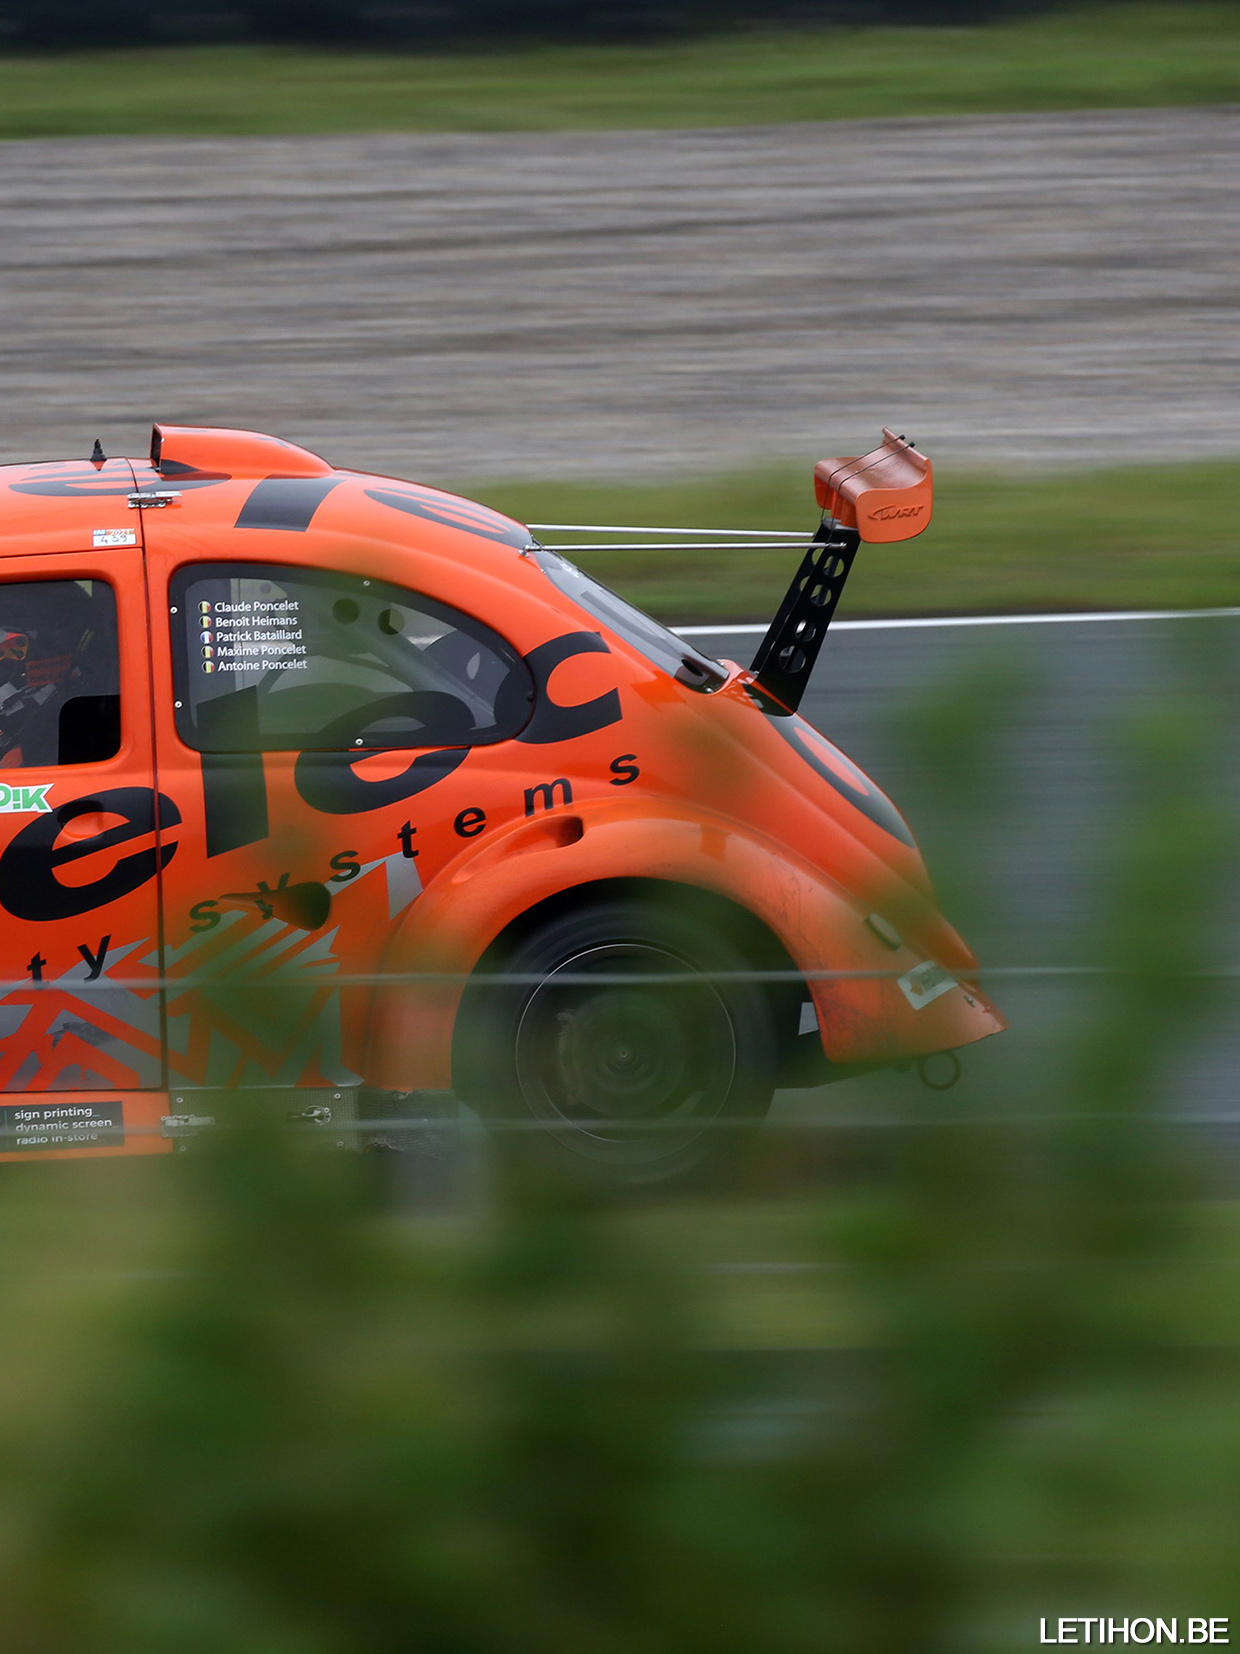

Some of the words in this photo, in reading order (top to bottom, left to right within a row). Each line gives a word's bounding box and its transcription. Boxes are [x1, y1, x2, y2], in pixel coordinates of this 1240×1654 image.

[215, 601, 252, 613] Claude
[253, 600, 299, 612] Poncelet
[215, 616, 250, 627] Benoît
[252, 616, 298, 626] Heimans
[216, 630, 252, 642] Patrick
[254, 629, 303, 640] Bataillard
[217, 645, 259, 657] Maxime
[261, 644, 306, 655] Poncelet
[218, 660, 260, 671] Antoine
[262, 659, 308, 670] Poncelet
[14, 1109, 40, 1121] sign
[15, 1120, 69, 1133] dynamic
[16, 1134, 48, 1145] radio
